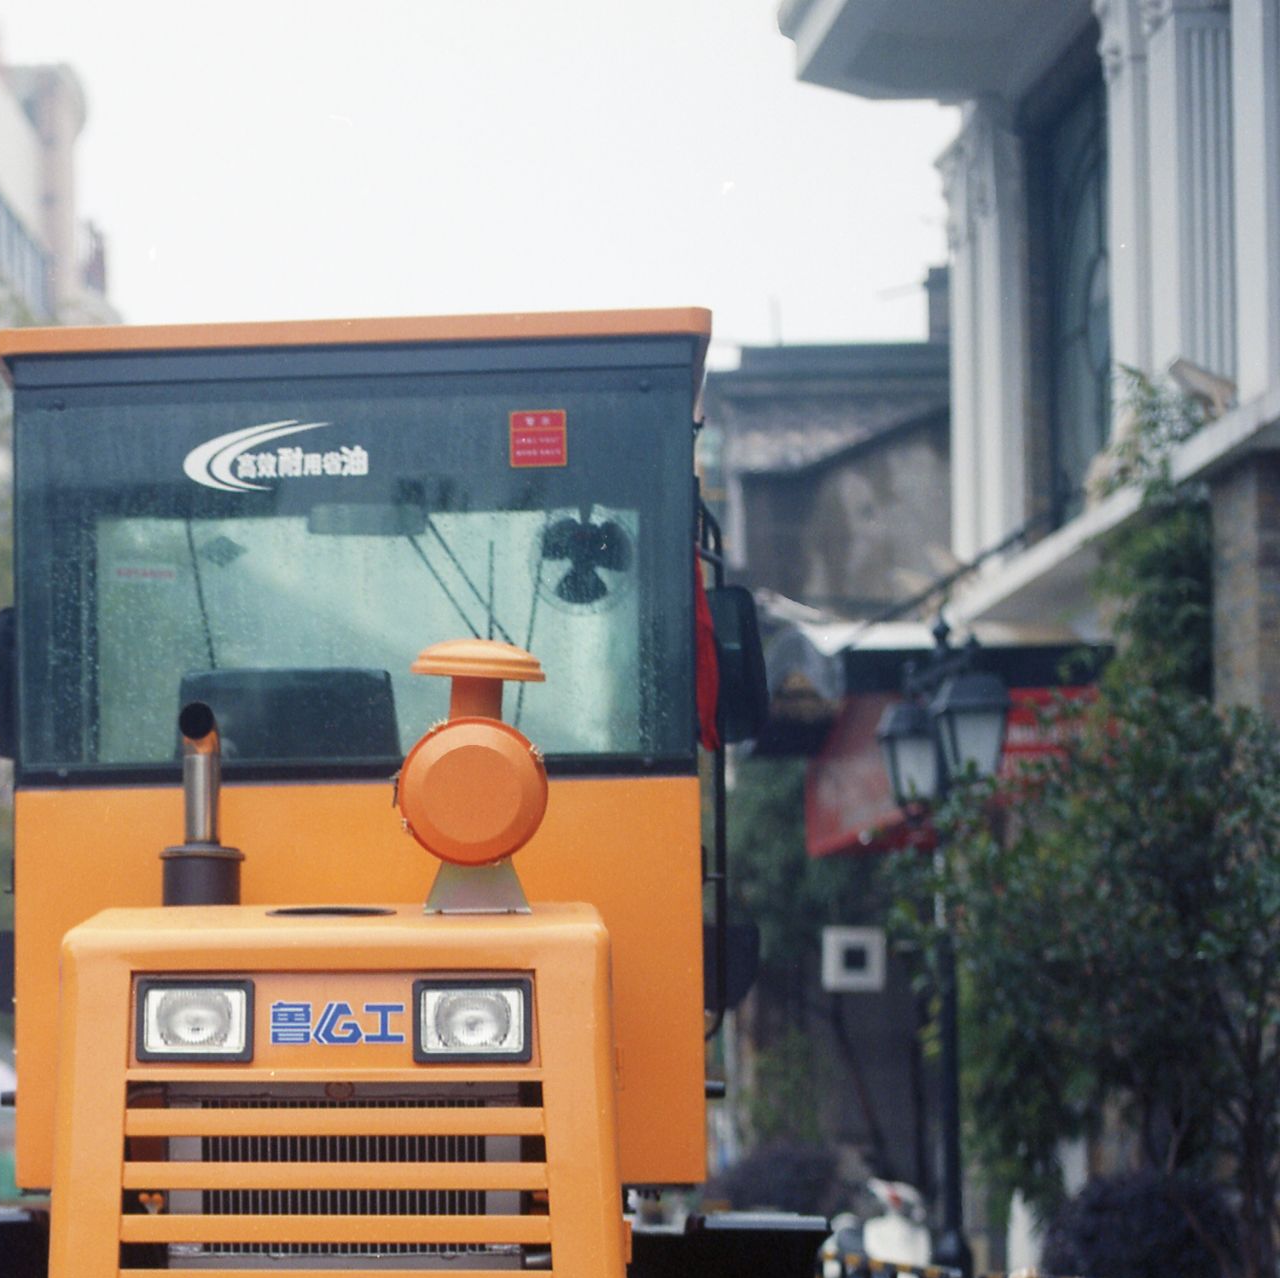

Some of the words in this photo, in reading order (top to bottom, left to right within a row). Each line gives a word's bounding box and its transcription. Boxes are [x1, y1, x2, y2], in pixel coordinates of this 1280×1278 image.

[237, 445, 369, 479] 高效耐用省油
